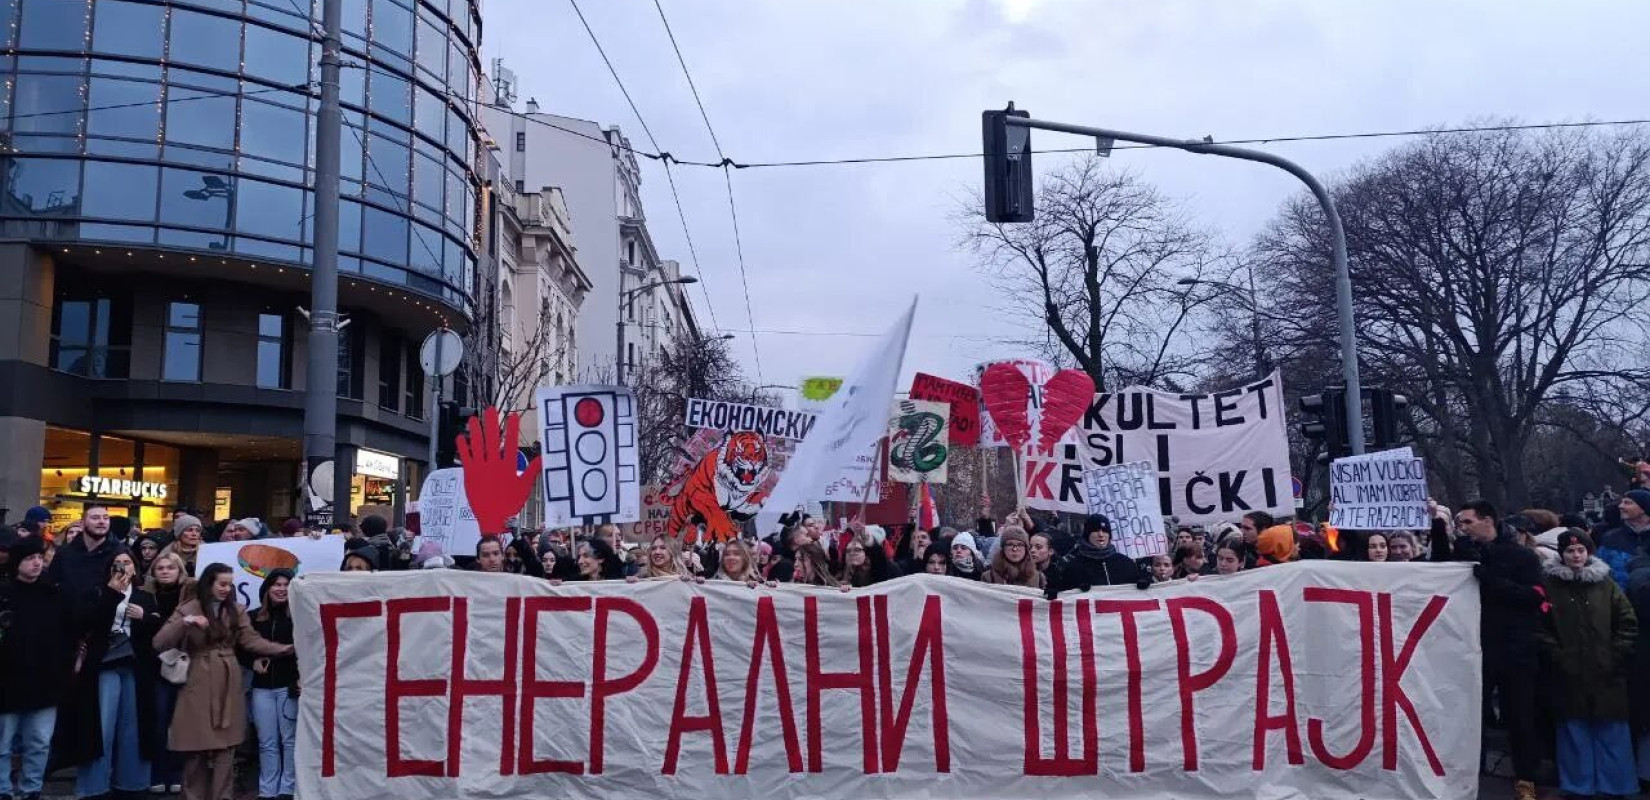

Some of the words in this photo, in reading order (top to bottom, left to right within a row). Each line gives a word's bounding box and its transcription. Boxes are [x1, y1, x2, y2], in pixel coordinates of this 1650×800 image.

[1084, 380, 1273, 431] KULTET
[689, 401, 816, 439] ЕКОНОМСКИ
[1331, 461, 1371, 483] NISAM
[1375, 459, 1424, 480] VUČKO
[81, 475, 167, 499] STARBUCKS
[1026, 461, 1277, 516] KRIČKI
[1356, 483, 1386, 503] IMAM
[1388, 483, 1428, 502] KOBRU
[1110, 515, 1155, 542] АРОД
[1330, 507, 1345, 527] DA
[1348, 507, 1364, 527] TE
[1367, 505, 1428, 528] RAZBACAM
[320, 597, 949, 778] ГЕНЕРАЛНИ
[1020, 588, 1446, 777] ШТРАЈК
